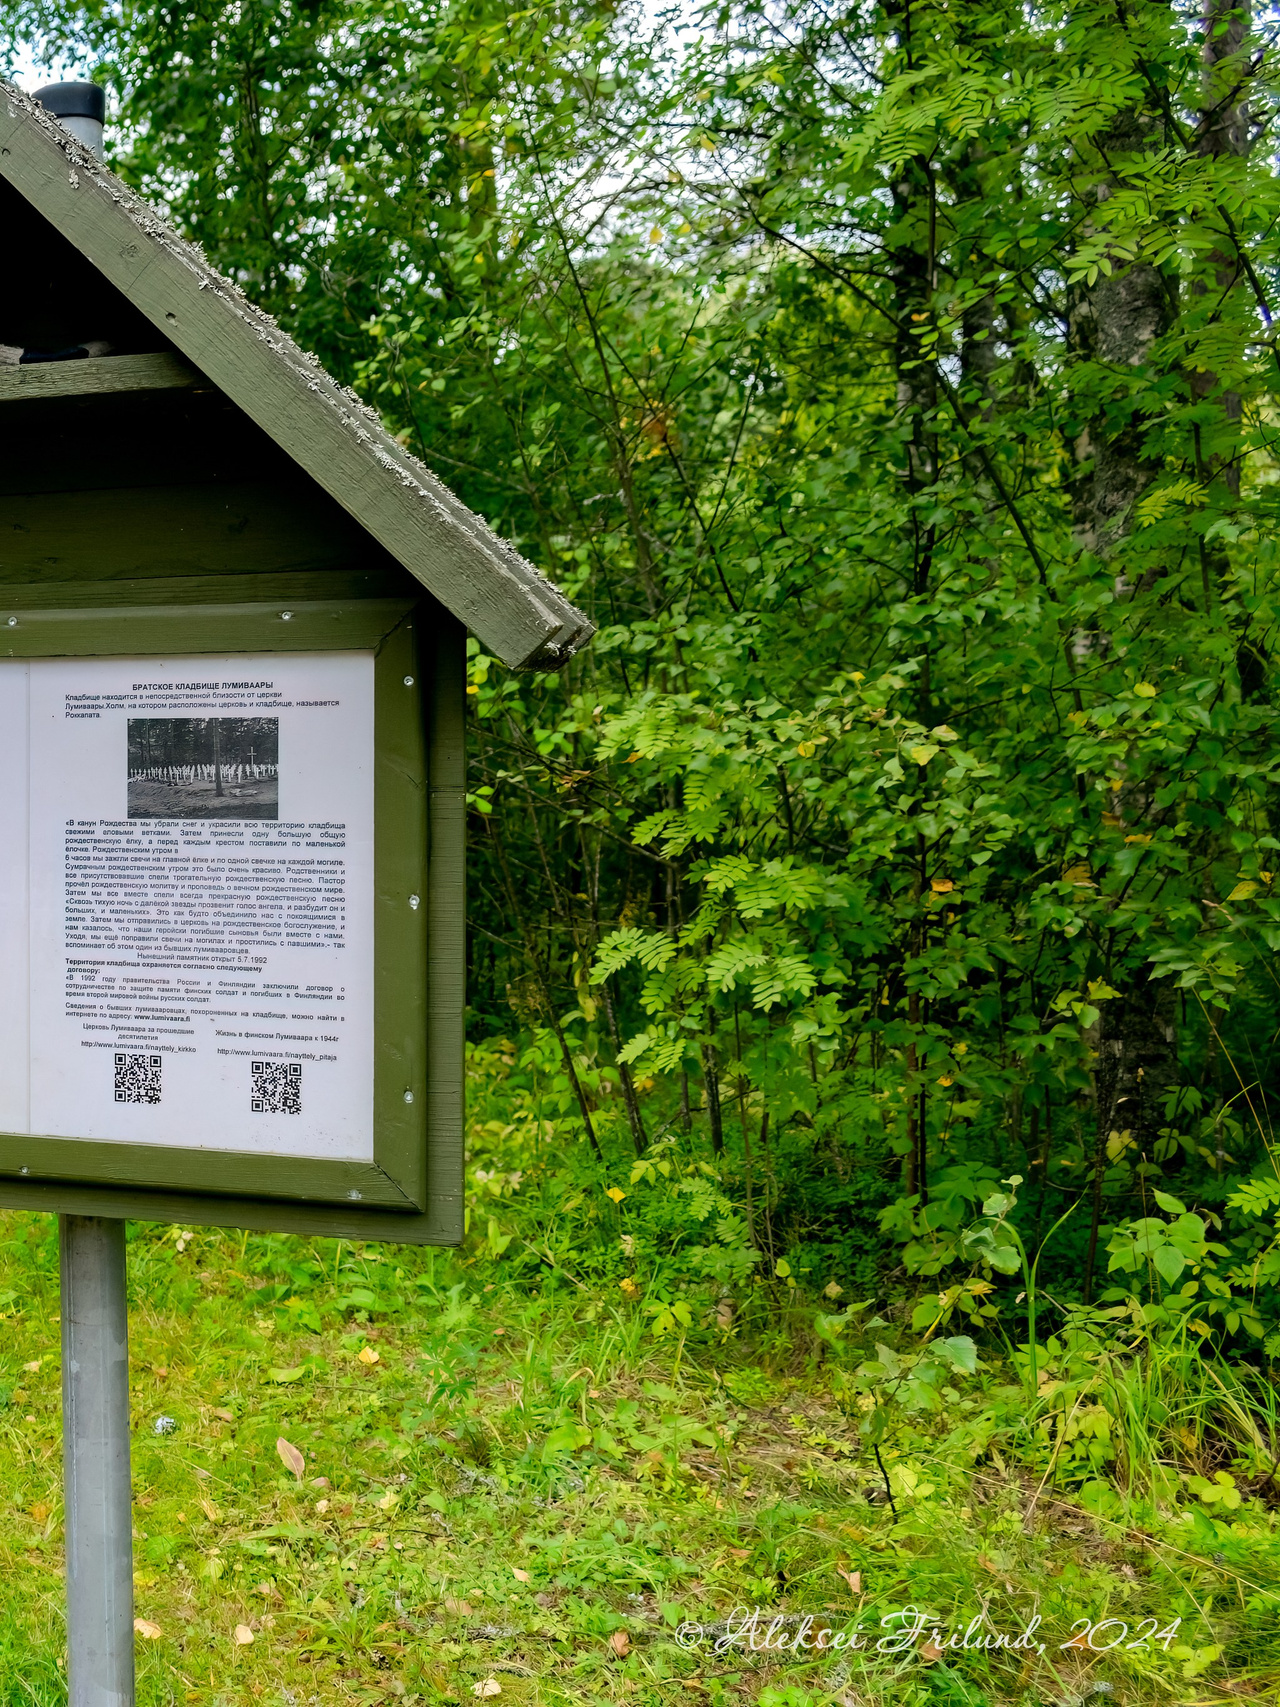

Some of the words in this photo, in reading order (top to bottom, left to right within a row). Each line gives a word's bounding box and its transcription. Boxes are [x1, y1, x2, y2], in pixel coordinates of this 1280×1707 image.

[133, 683, 173, 691] БРАТСКОЕ
[176, 682, 219, 691] КЛАДБИЩЕ
[222, 681, 274, 689] ЛУМИВААРЫ
[169, 702, 217, 710] расположены
[100, 819, 137, 827] Рождества
[154, 820, 179, 829] убрали
[309, 822, 346, 830] кладбища
[278, 830, 311, 839] большую
[320, 831, 346, 840] общую
[65, 838, 121, 846] рождественскую
[66, 958, 105, 967] Территория
[107, 960, 140, 968] кладбища
[216, 965, 263, 974] следующему
[66, 1011, 97, 1019] интернете
[134, 1014, 191, 1022] www.lumivaara.fi
[83, 1022, 109, 1031] Церковь
[111, 1024, 146, 1034] Лумиваара
[216, 1029, 237, 1037] Жизнь
[244, 1031, 274, 1039] финском
[276, 1032, 313, 1042] Лумиваара
